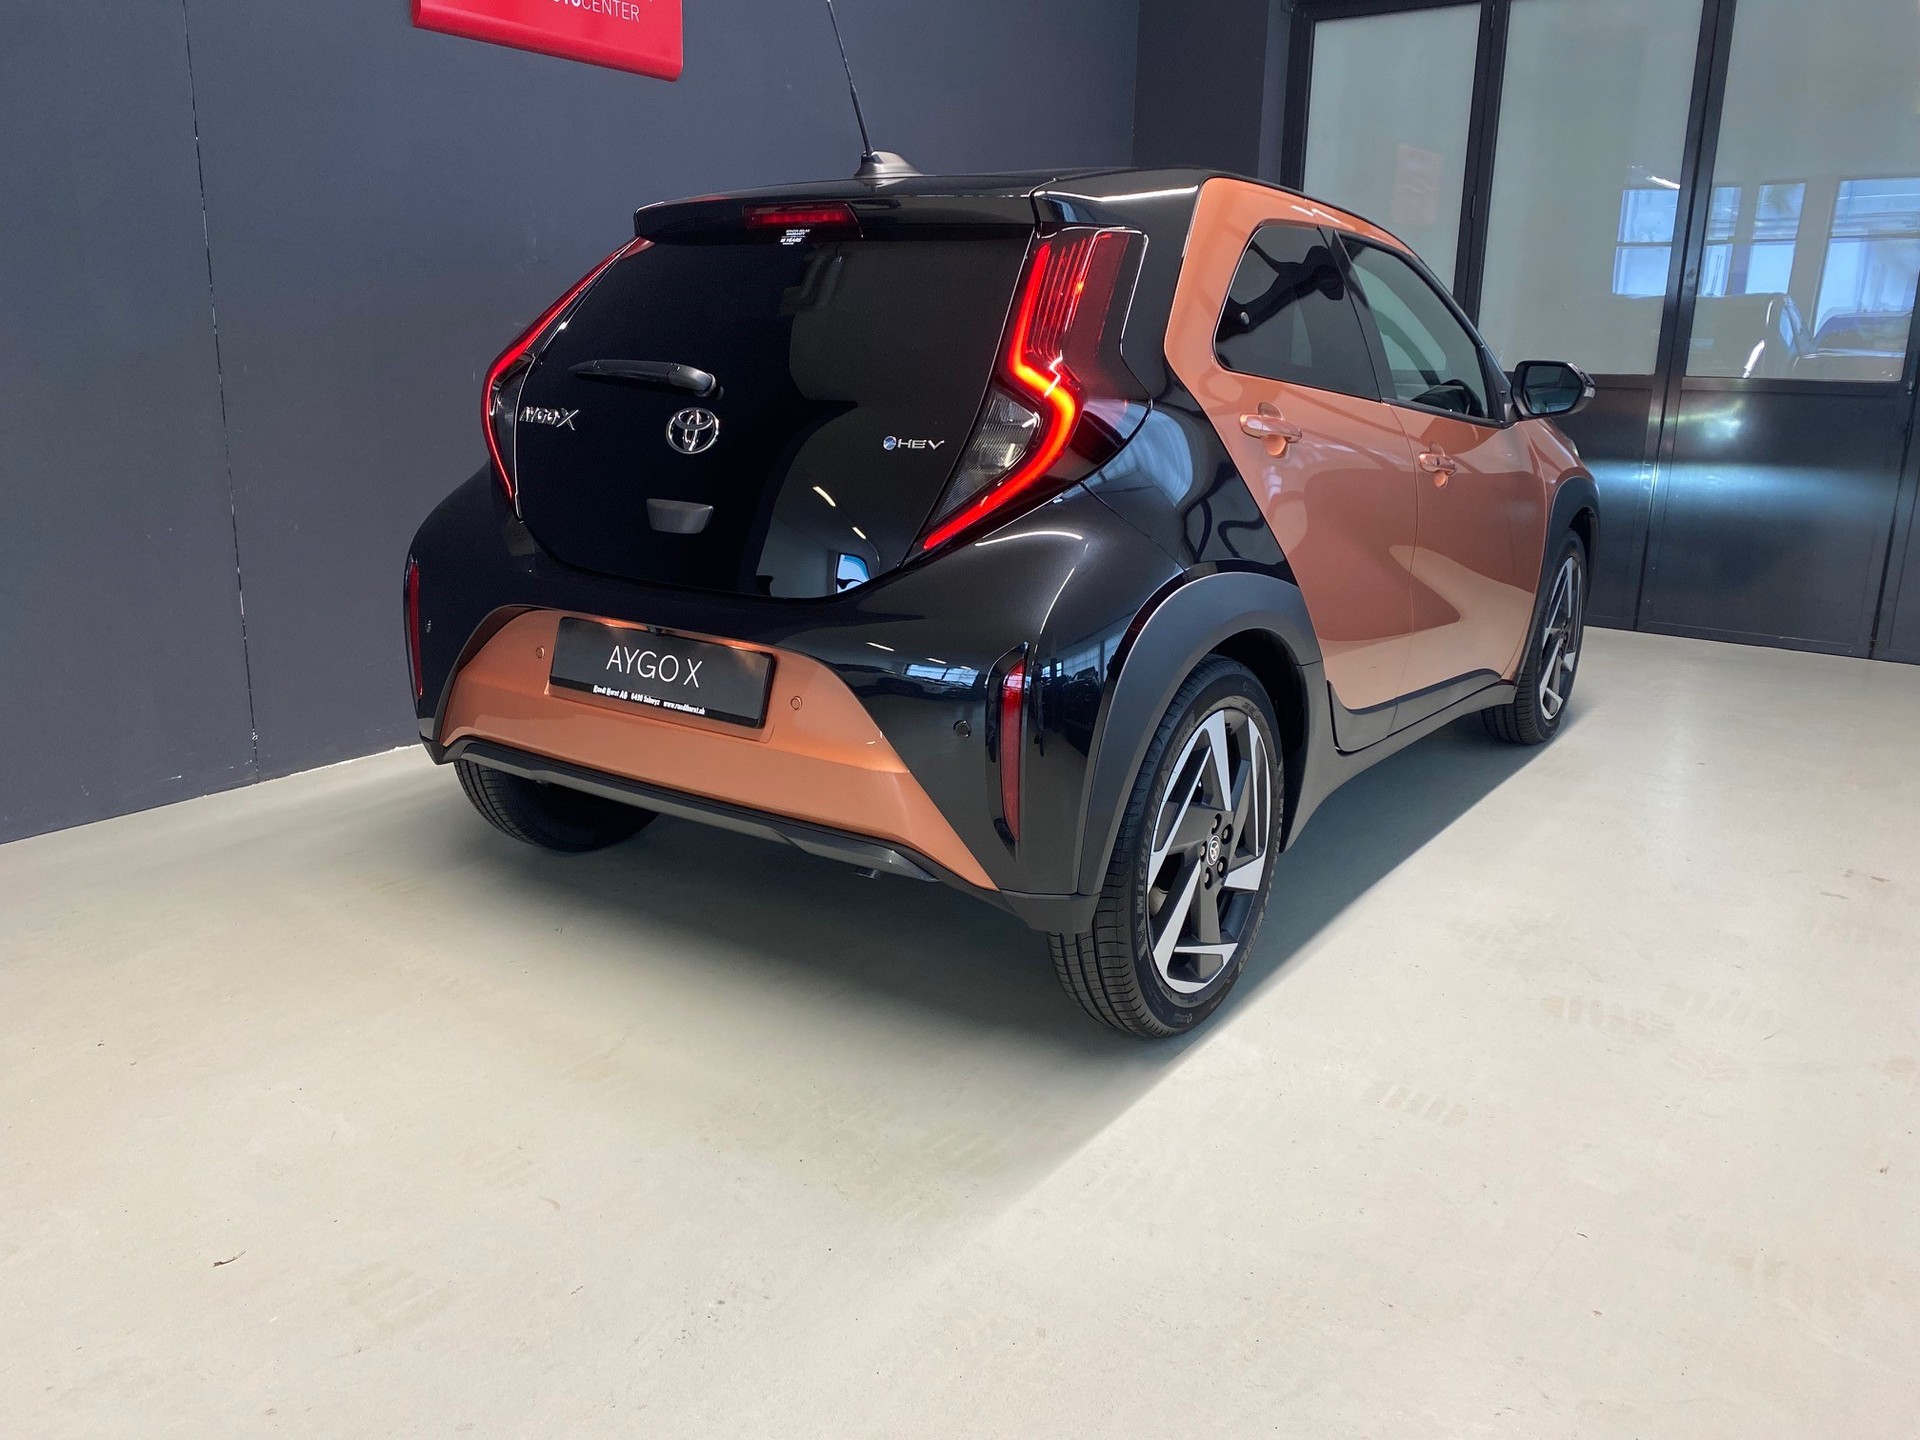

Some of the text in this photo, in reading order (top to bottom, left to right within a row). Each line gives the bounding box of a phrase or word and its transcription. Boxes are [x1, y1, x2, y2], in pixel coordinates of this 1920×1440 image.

[553, 0, 640, 22] CENTER
[897, 438, 945, 450] HEV
[606, 645, 703, 688] AYGO X
[619, 690, 628, 699] AG
